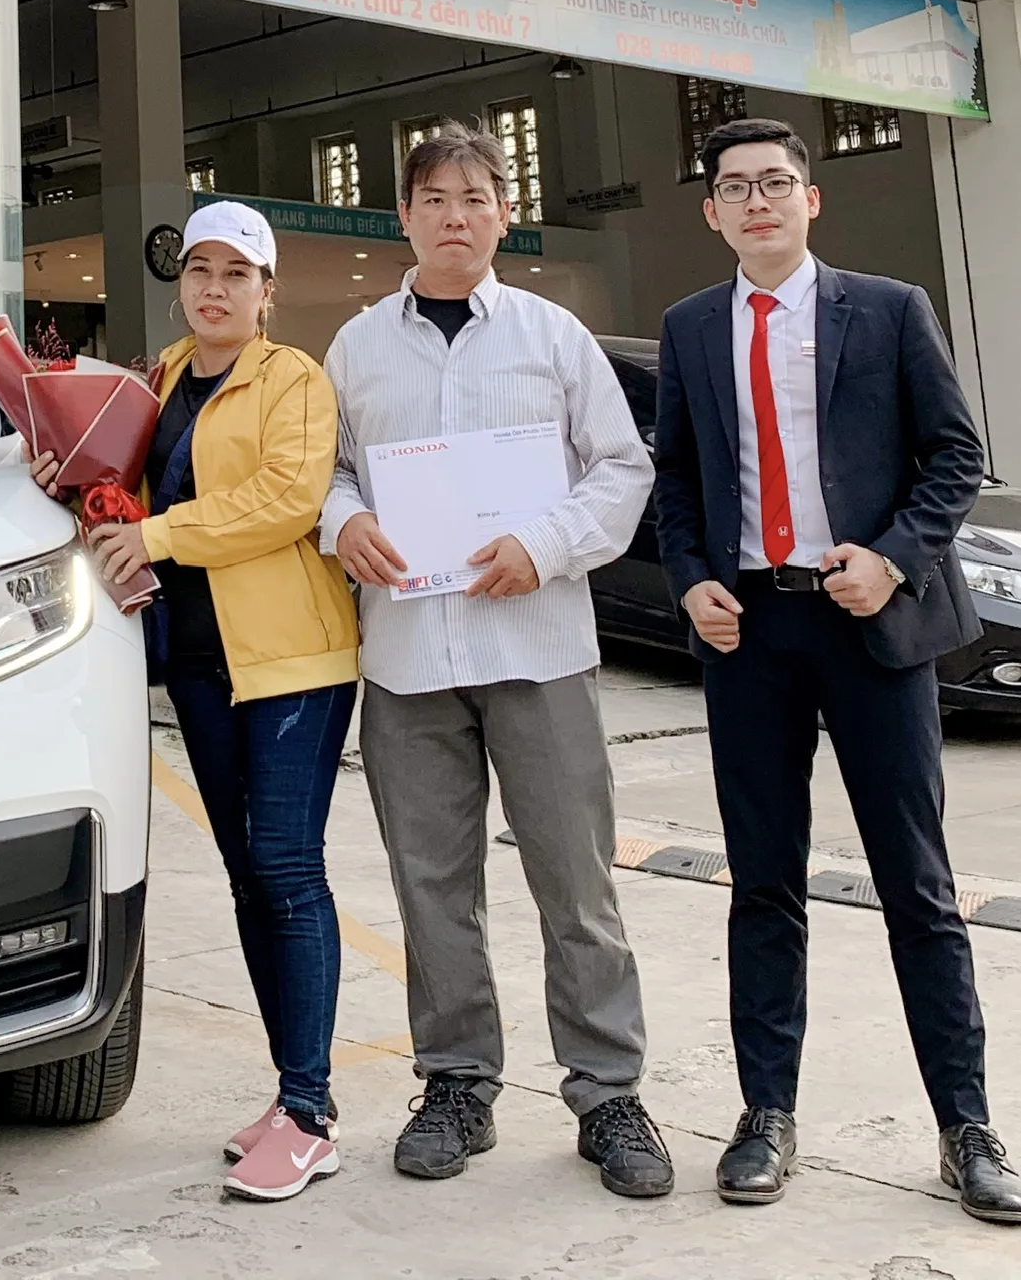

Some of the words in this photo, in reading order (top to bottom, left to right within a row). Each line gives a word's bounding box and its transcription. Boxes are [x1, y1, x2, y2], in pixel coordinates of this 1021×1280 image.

[430, 0, 470, 28] đến
[475, 8, 514, 37] thứ
[519, 16, 531, 39] 7
[630, 0, 657, 24] ĐẶT
[660, 8, 690, 29] LỊCH
[723, 15, 750, 40] SỬA
[751, 23, 788, 46] CHỮA
[616, 32, 652, 59] 028
[271, 209, 306, 227] MANG
[311, 211, 352, 233] NHỮNG
[391, 442, 450, 457] HONDA
[407, 576, 430, 590] HPT
